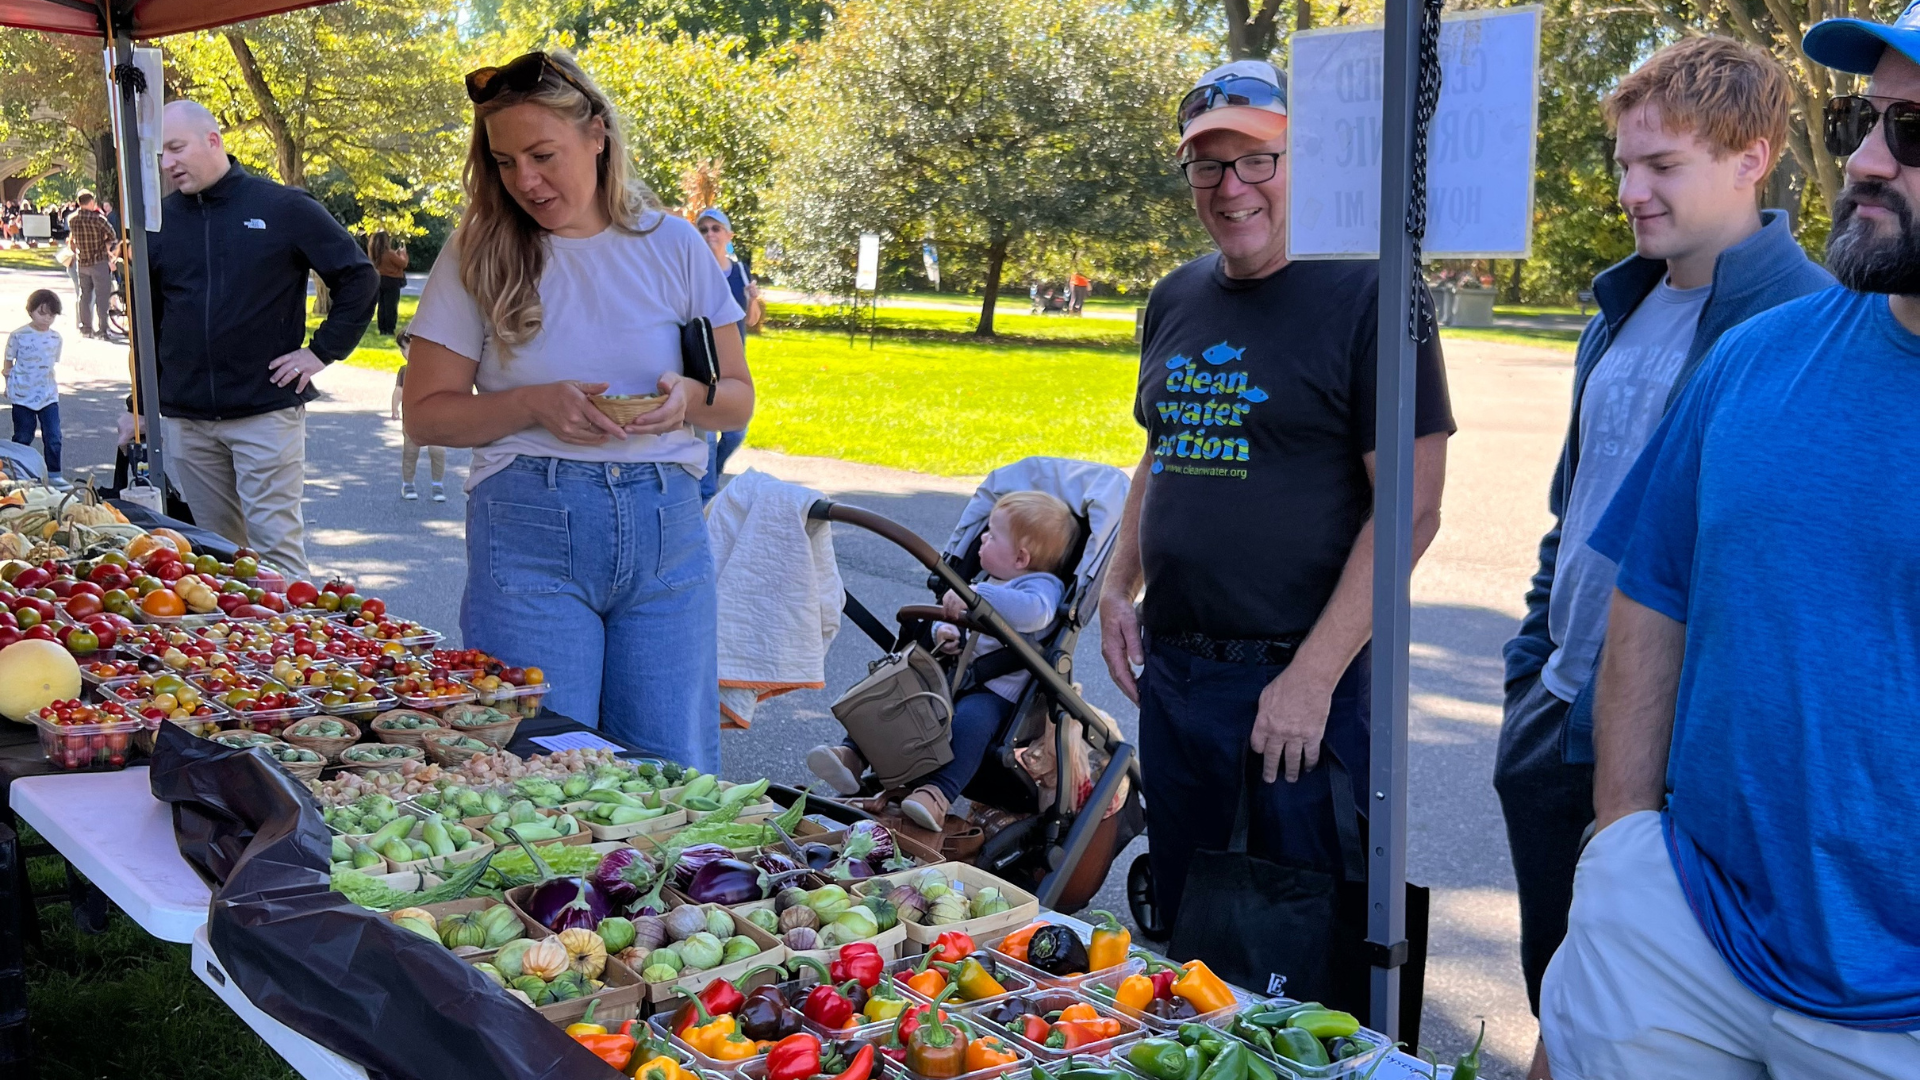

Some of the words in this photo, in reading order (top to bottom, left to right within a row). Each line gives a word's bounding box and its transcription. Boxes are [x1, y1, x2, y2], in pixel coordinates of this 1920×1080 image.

[1166, 363, 1249, 395] clean
[1156, 399, 1250, 426] water
[1154, 429, 1250, 461] action
[1165, 464, 1248, 479] www.cleanwater.org
